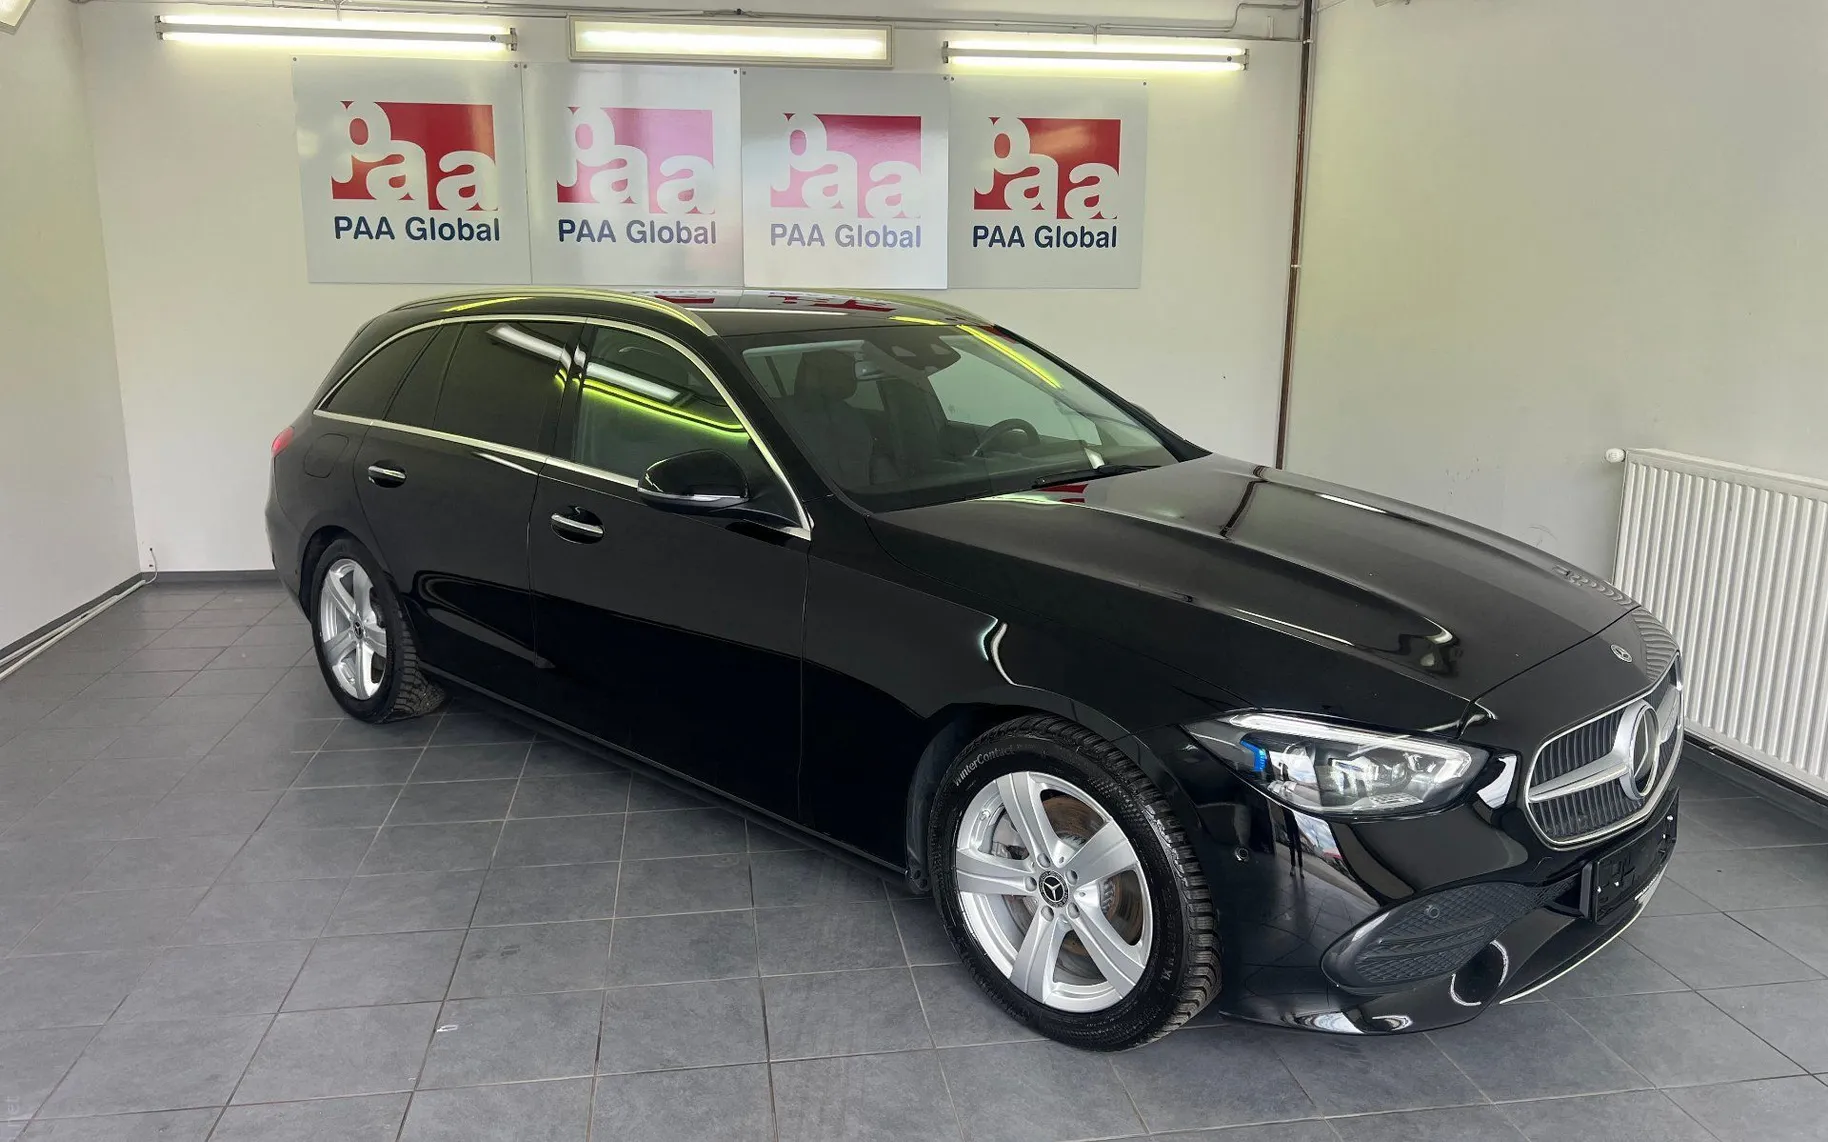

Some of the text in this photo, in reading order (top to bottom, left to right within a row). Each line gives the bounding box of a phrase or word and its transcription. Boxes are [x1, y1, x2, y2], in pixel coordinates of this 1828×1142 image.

[334, 216, 500, 242] PAA Global
[558, 219, 717, 245] PAA Global
[770, 223, 921, 249] PAA Global
[972, 225, 1117, 249] PAA Global
